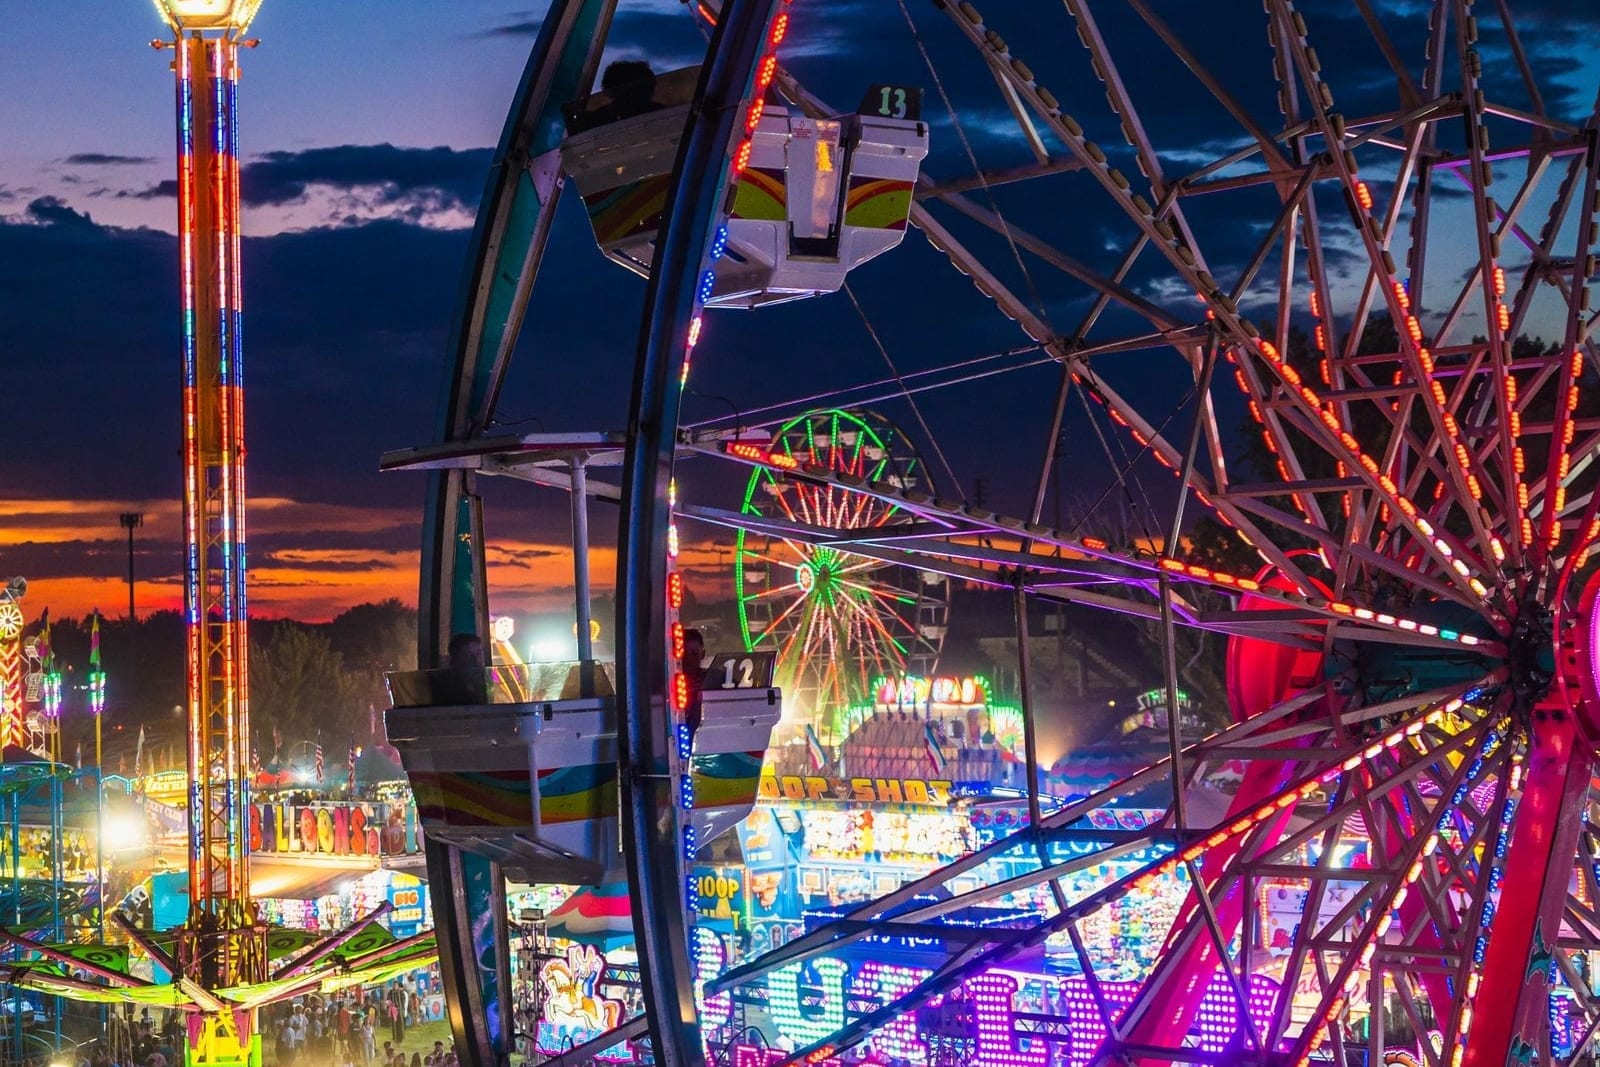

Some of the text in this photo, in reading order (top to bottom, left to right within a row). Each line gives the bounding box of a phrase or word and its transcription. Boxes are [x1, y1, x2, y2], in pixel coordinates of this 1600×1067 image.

[879, 87, 906, 118] 13
[721, 659, 753, 688] 12
[759, 776, 828, 800] OOP
[851, 777, 952, 806] SHOT
[249, 803, 366, 855] BALLOONS
